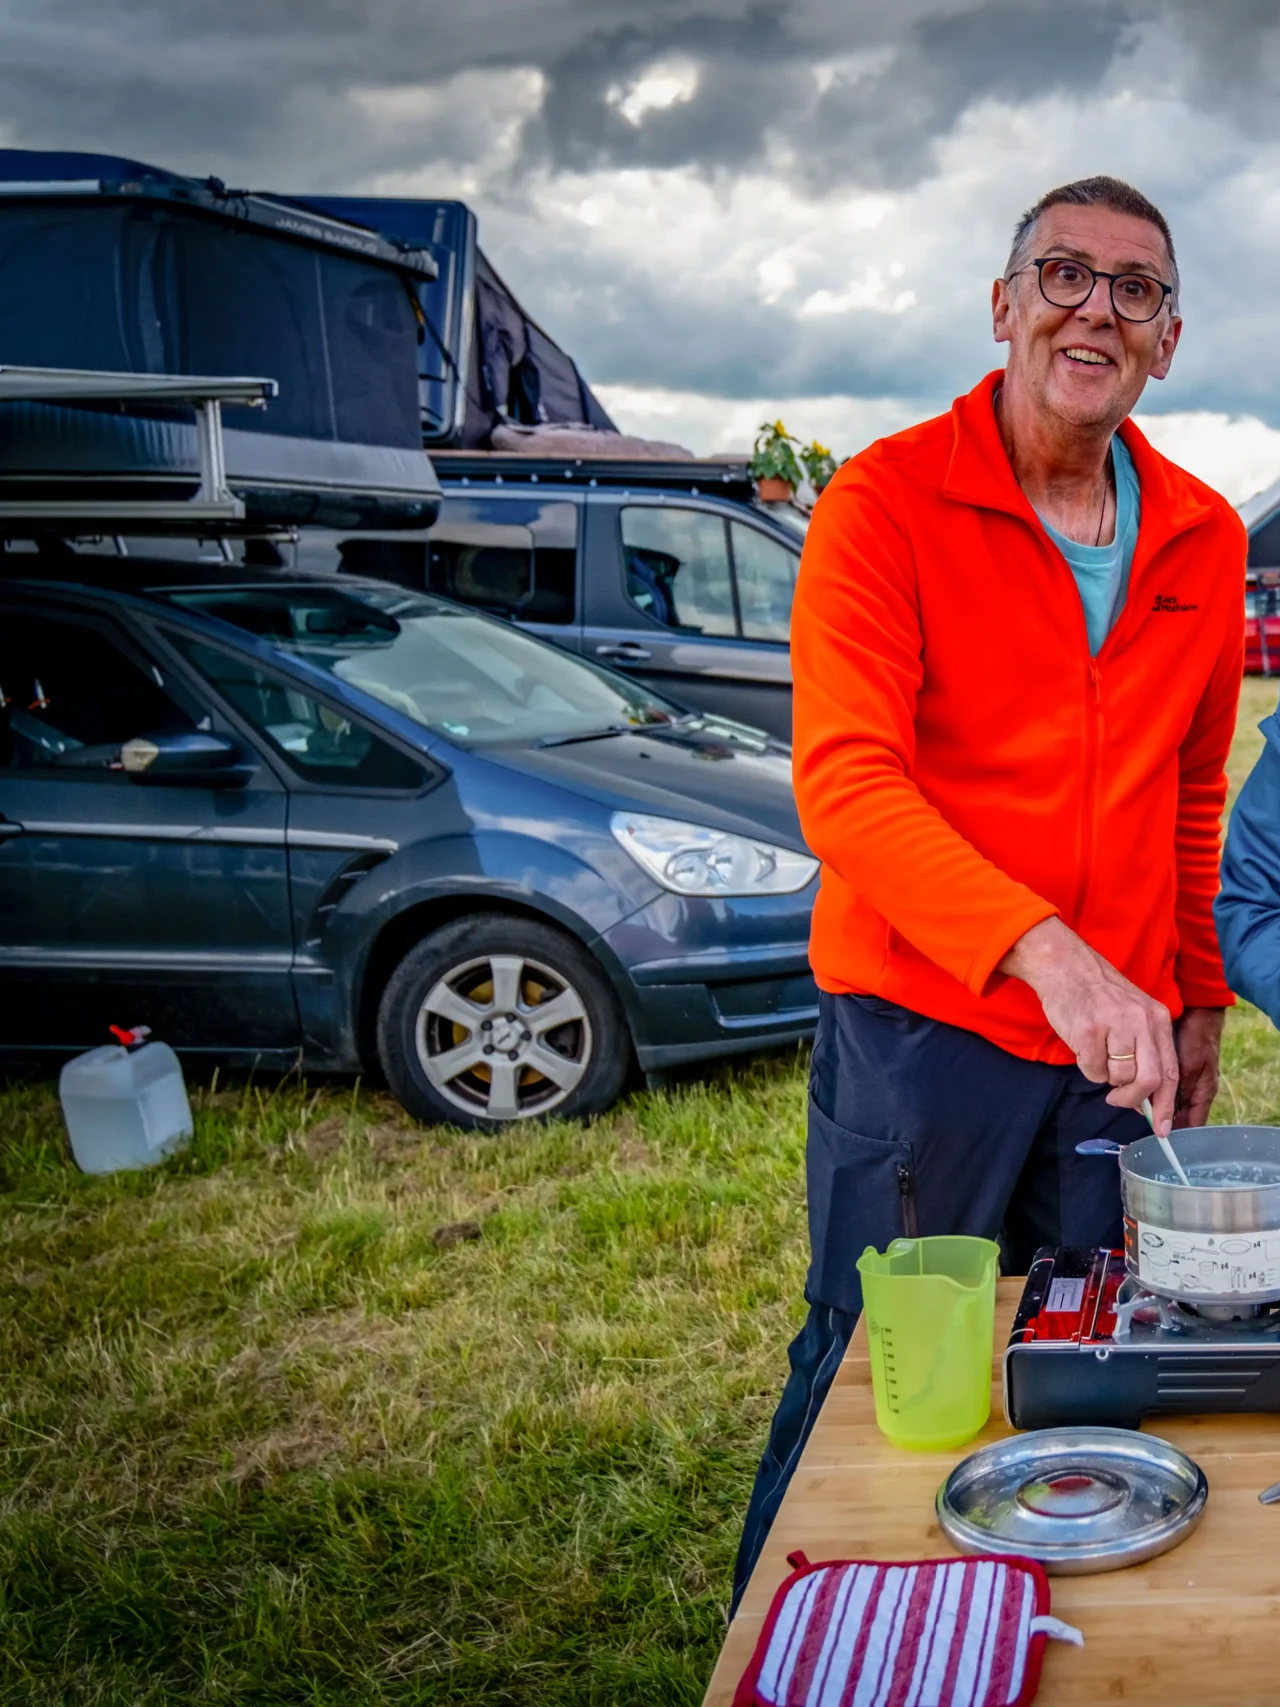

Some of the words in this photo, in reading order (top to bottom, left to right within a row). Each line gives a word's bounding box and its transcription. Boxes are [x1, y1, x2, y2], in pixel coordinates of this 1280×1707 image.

[1253, 1240, 1261, 1248] x4
[1221, 1262, 1229, 1270] x4
[1249, 1272, 1257, 1280] x4
